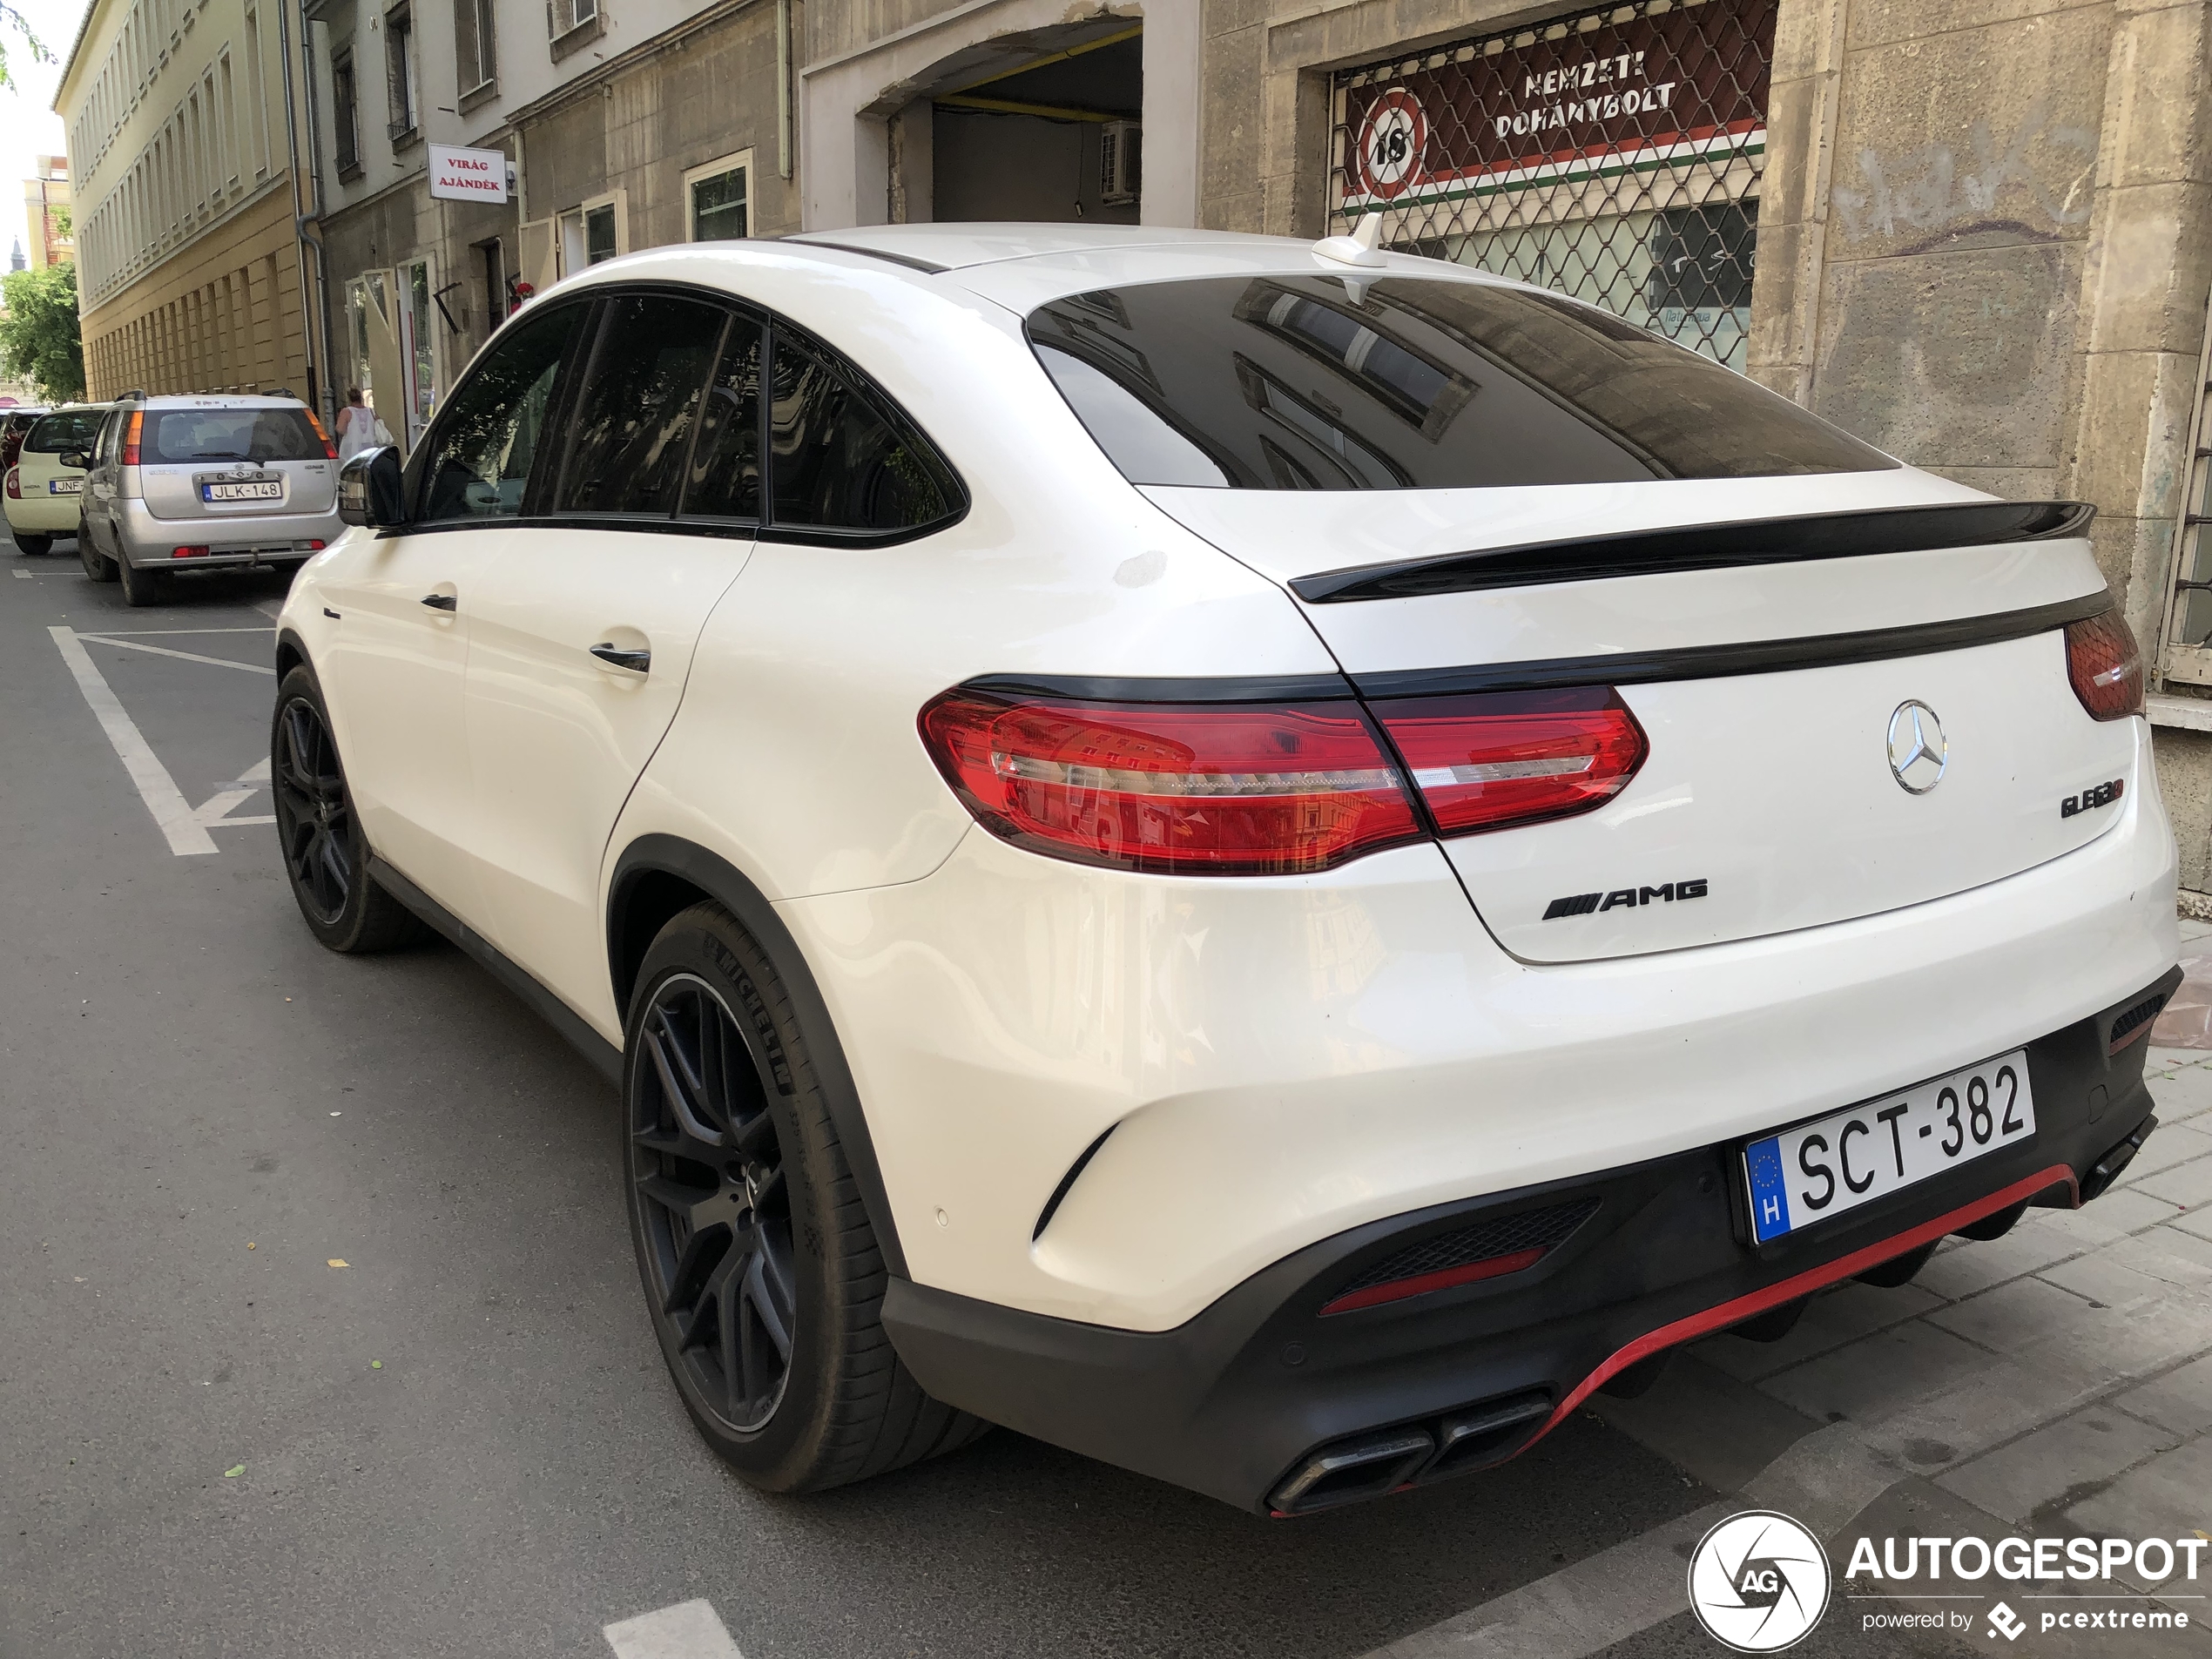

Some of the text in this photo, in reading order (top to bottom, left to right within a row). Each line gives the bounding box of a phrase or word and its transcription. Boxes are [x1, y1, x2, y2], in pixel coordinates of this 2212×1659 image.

[1525, 51, 1644, 98] NEMZETI
[1497, 82, 1676, 138] DOHÁNYBOLT
[439, 177, 500, 191] AJÁNDÉK
[448, 158, 489, 171] VIRÁG
[215, 482, 278, 498] JLK-148
[1599, 878, 1708, 912] AMG
[717, 949, 792, 1086] MICHELIN
[1762, 1065, 2024, 1224] H SCT-382
